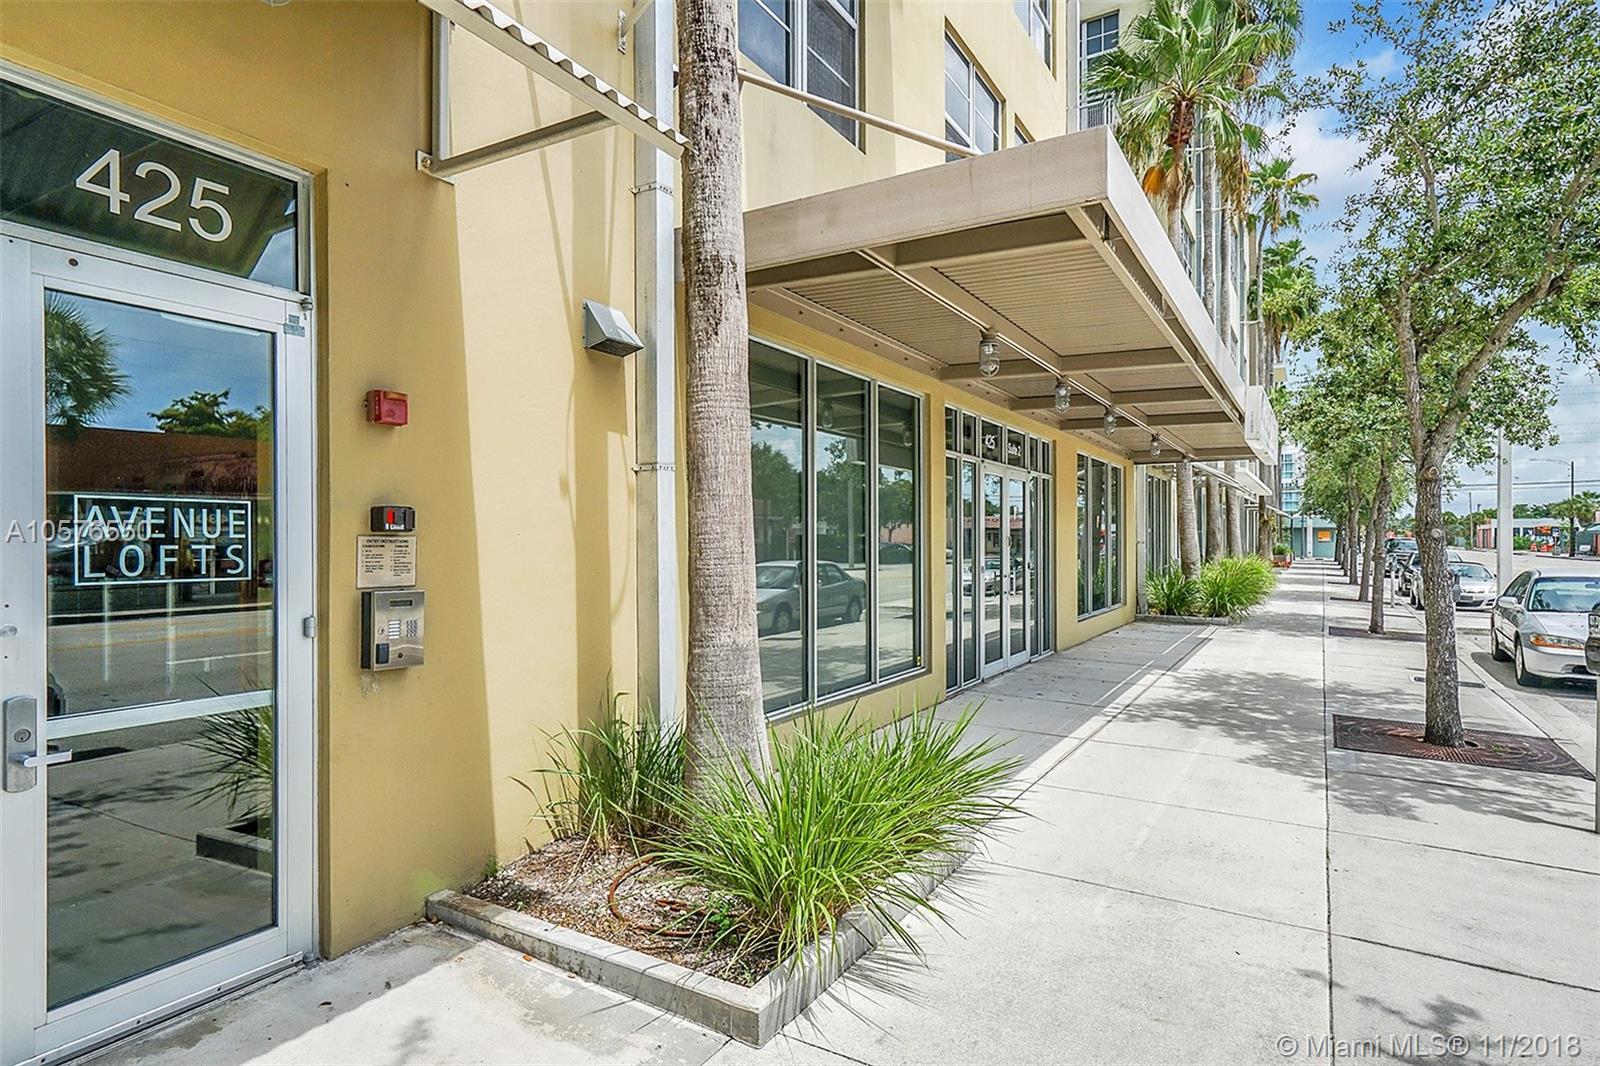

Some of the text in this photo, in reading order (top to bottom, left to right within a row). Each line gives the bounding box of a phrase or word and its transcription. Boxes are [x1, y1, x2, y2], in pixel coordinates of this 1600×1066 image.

[75, 148, 233, 242] 425
[82, 505, 246, 539] AVENUE
[83, 545, 245, 578] LOFTS
